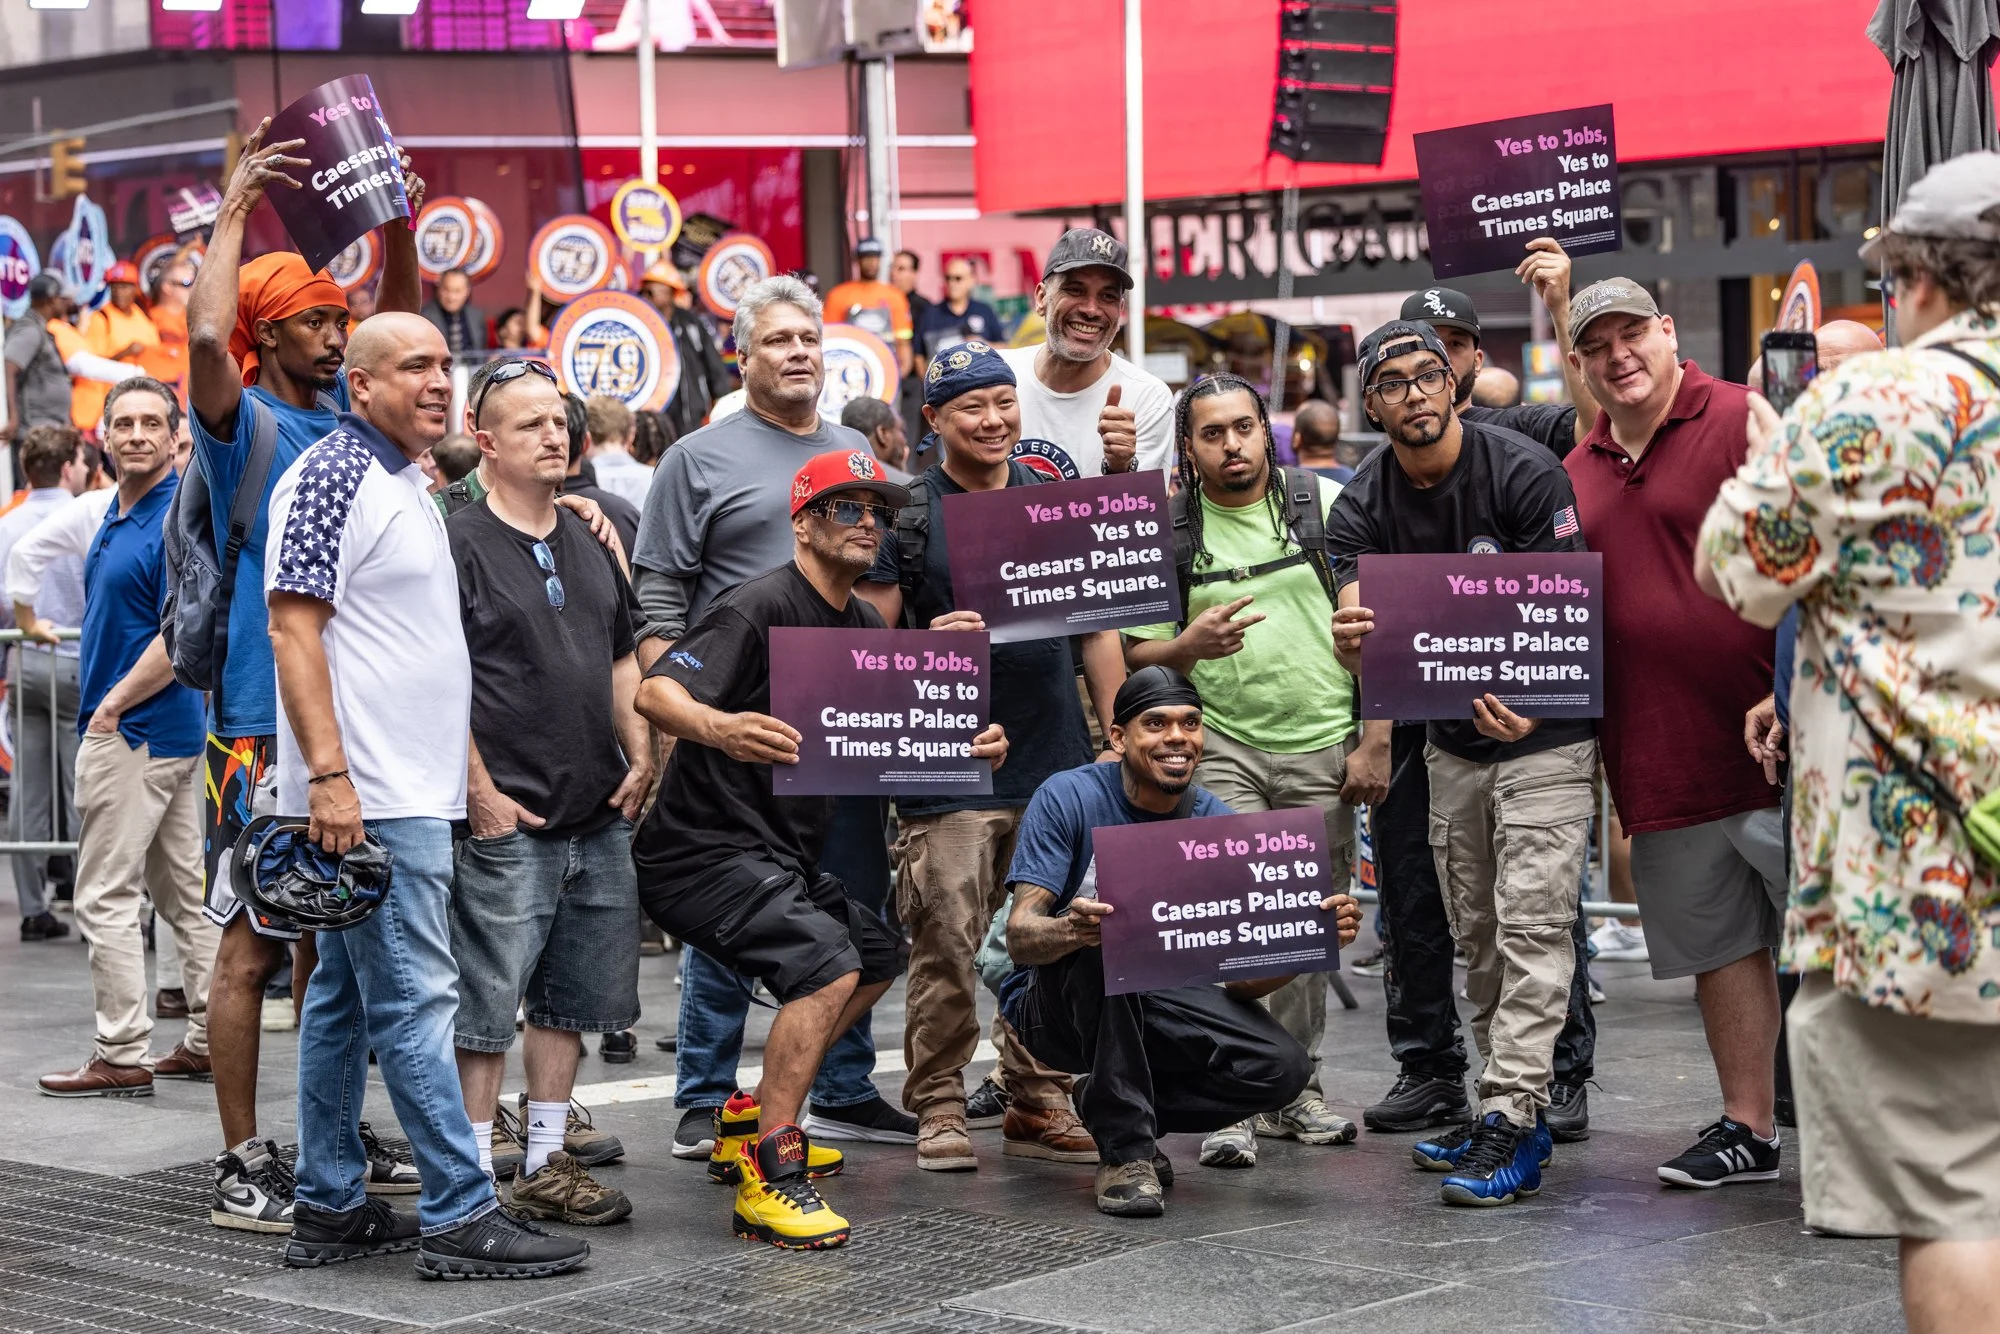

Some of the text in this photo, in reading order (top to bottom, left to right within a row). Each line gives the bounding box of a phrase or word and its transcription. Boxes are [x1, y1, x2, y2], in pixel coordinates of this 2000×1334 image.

[309, 102, 350, 128] Yes
[351, 96, 372, 112] to
[1494, 126, 1607, 157] Yes to Jobs,
[311, 144, 387, 192] Caesars
[1558, 152, 1609, 173] Yes to
[326, 169, 392, 210] Times
[1472, 178, 1611, 213] Caesars Palace
[1479, 205, 1614, 238] Times Square.
[1091, 235, 1113, 258] NY
[1576, 292, 1595, 318] NEW
[573, 340, 649, 391] 79
[1025, 493, 1156, 523] Yes to Jobs,
[1090, 520, 1158, 542] Yes to
[1000, 547, 1162, 581] Caesars Palace
[1007, 574, 1166, 606] Times Square.
[1446, 574, 1590, 598] Yes to Jobs,
[1517, 603, 1590, 623] Yes to
[1413, 631, 1590, 652] Caesars Palace
[851, 650, 978, 676] Yes to Jobs,
[1418, 660, 1590, 686] Times Square.
[913, 680, 978, 700] Yes to
[820, 707, 978, 729] Caesars Palace
[826, 736, 972, 762] Times Square
[1178, 830, 1316, 860] Yes to Jobs,
[1248, 860, 1318, 883] Yes to
[1152, 889, 1322, 923] Caesars Palace
[1158, 920, 1324, 951] Times Square.
